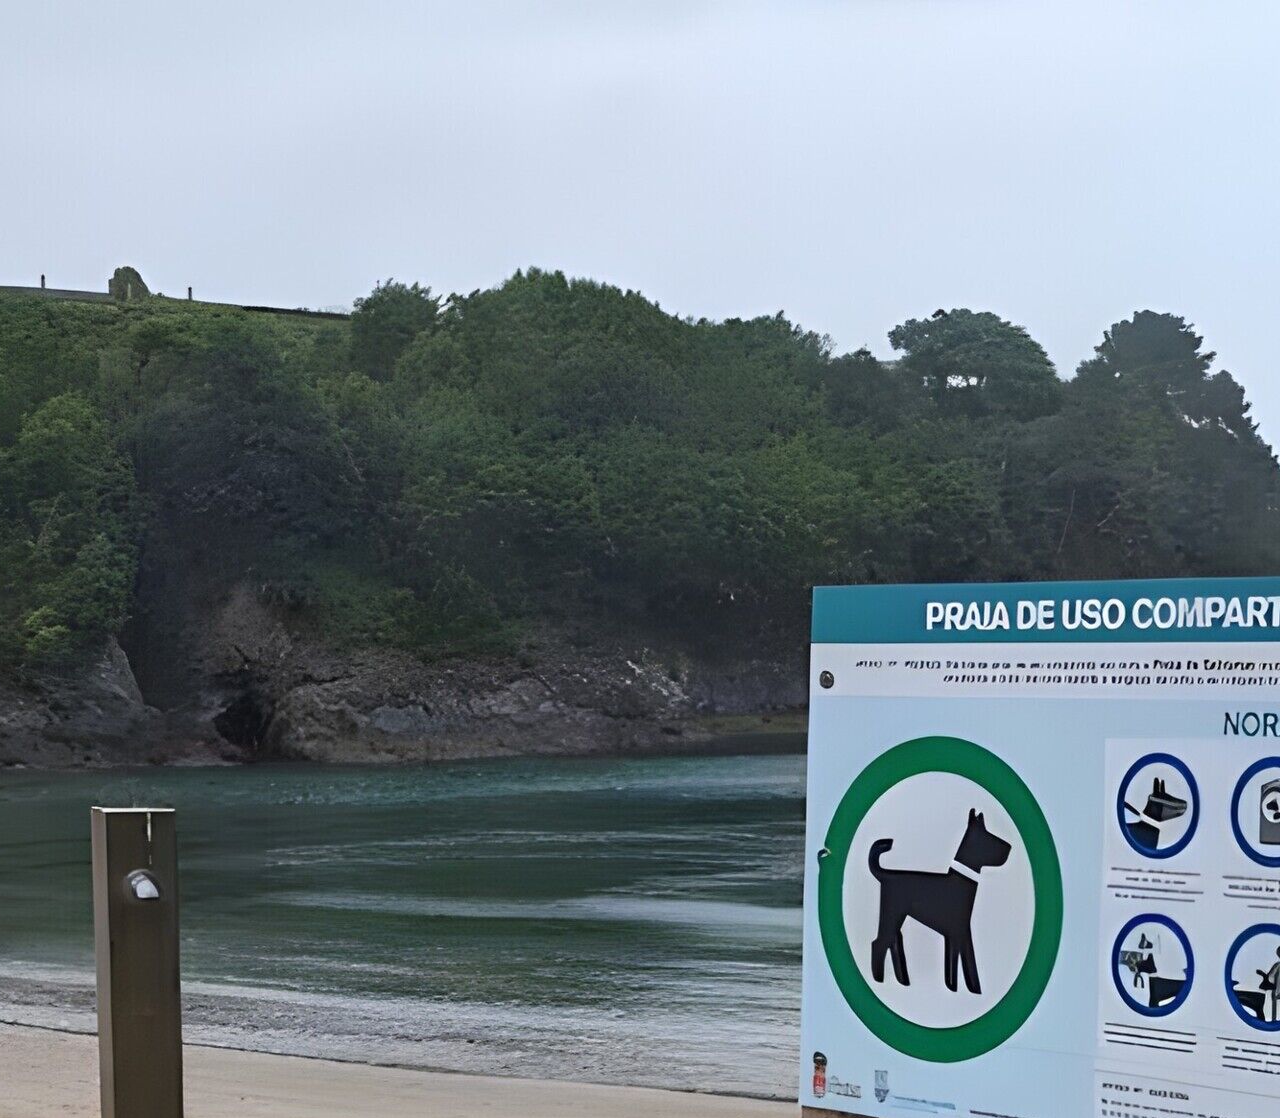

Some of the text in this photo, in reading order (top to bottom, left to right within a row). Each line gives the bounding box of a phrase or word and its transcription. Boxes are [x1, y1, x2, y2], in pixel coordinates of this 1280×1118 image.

[926, 600, 1010, 631] PRAIA
[1016, 598, 1055, 630] DE
[1062, 597, 1126, 630] USO
